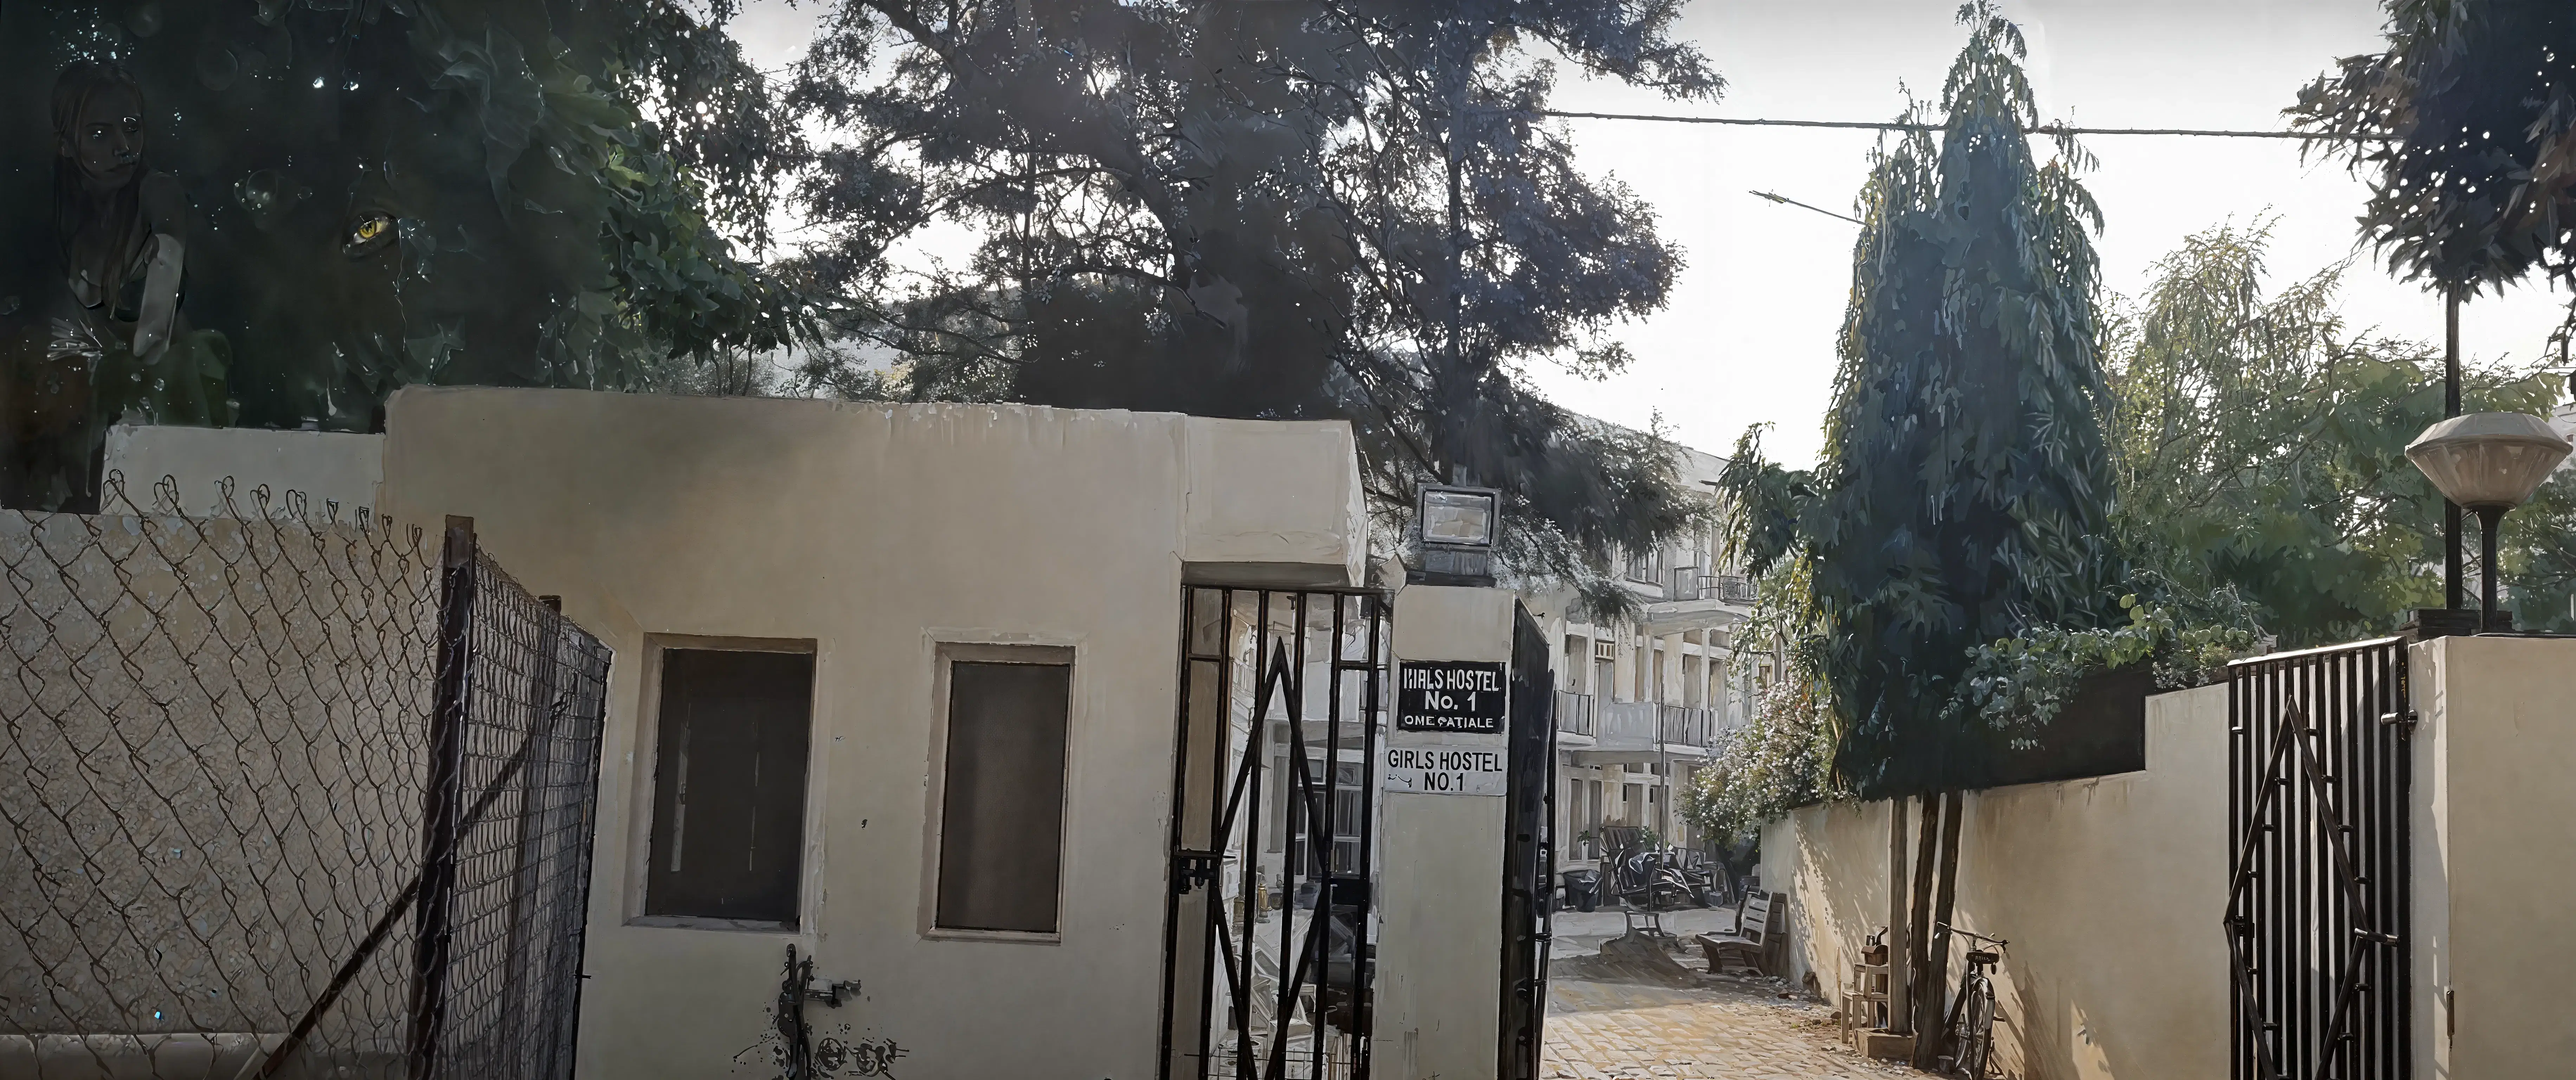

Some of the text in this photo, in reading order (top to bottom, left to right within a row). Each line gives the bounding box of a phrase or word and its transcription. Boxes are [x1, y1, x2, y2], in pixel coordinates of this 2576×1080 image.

[1447, 669, 1499, 691] HOSTEL
[1467, 692, 1476, 711] 1
[1388, 749, 1502, 772] GIRLS HOSTEL
[1424, 772, 1463, 791] NO.1
